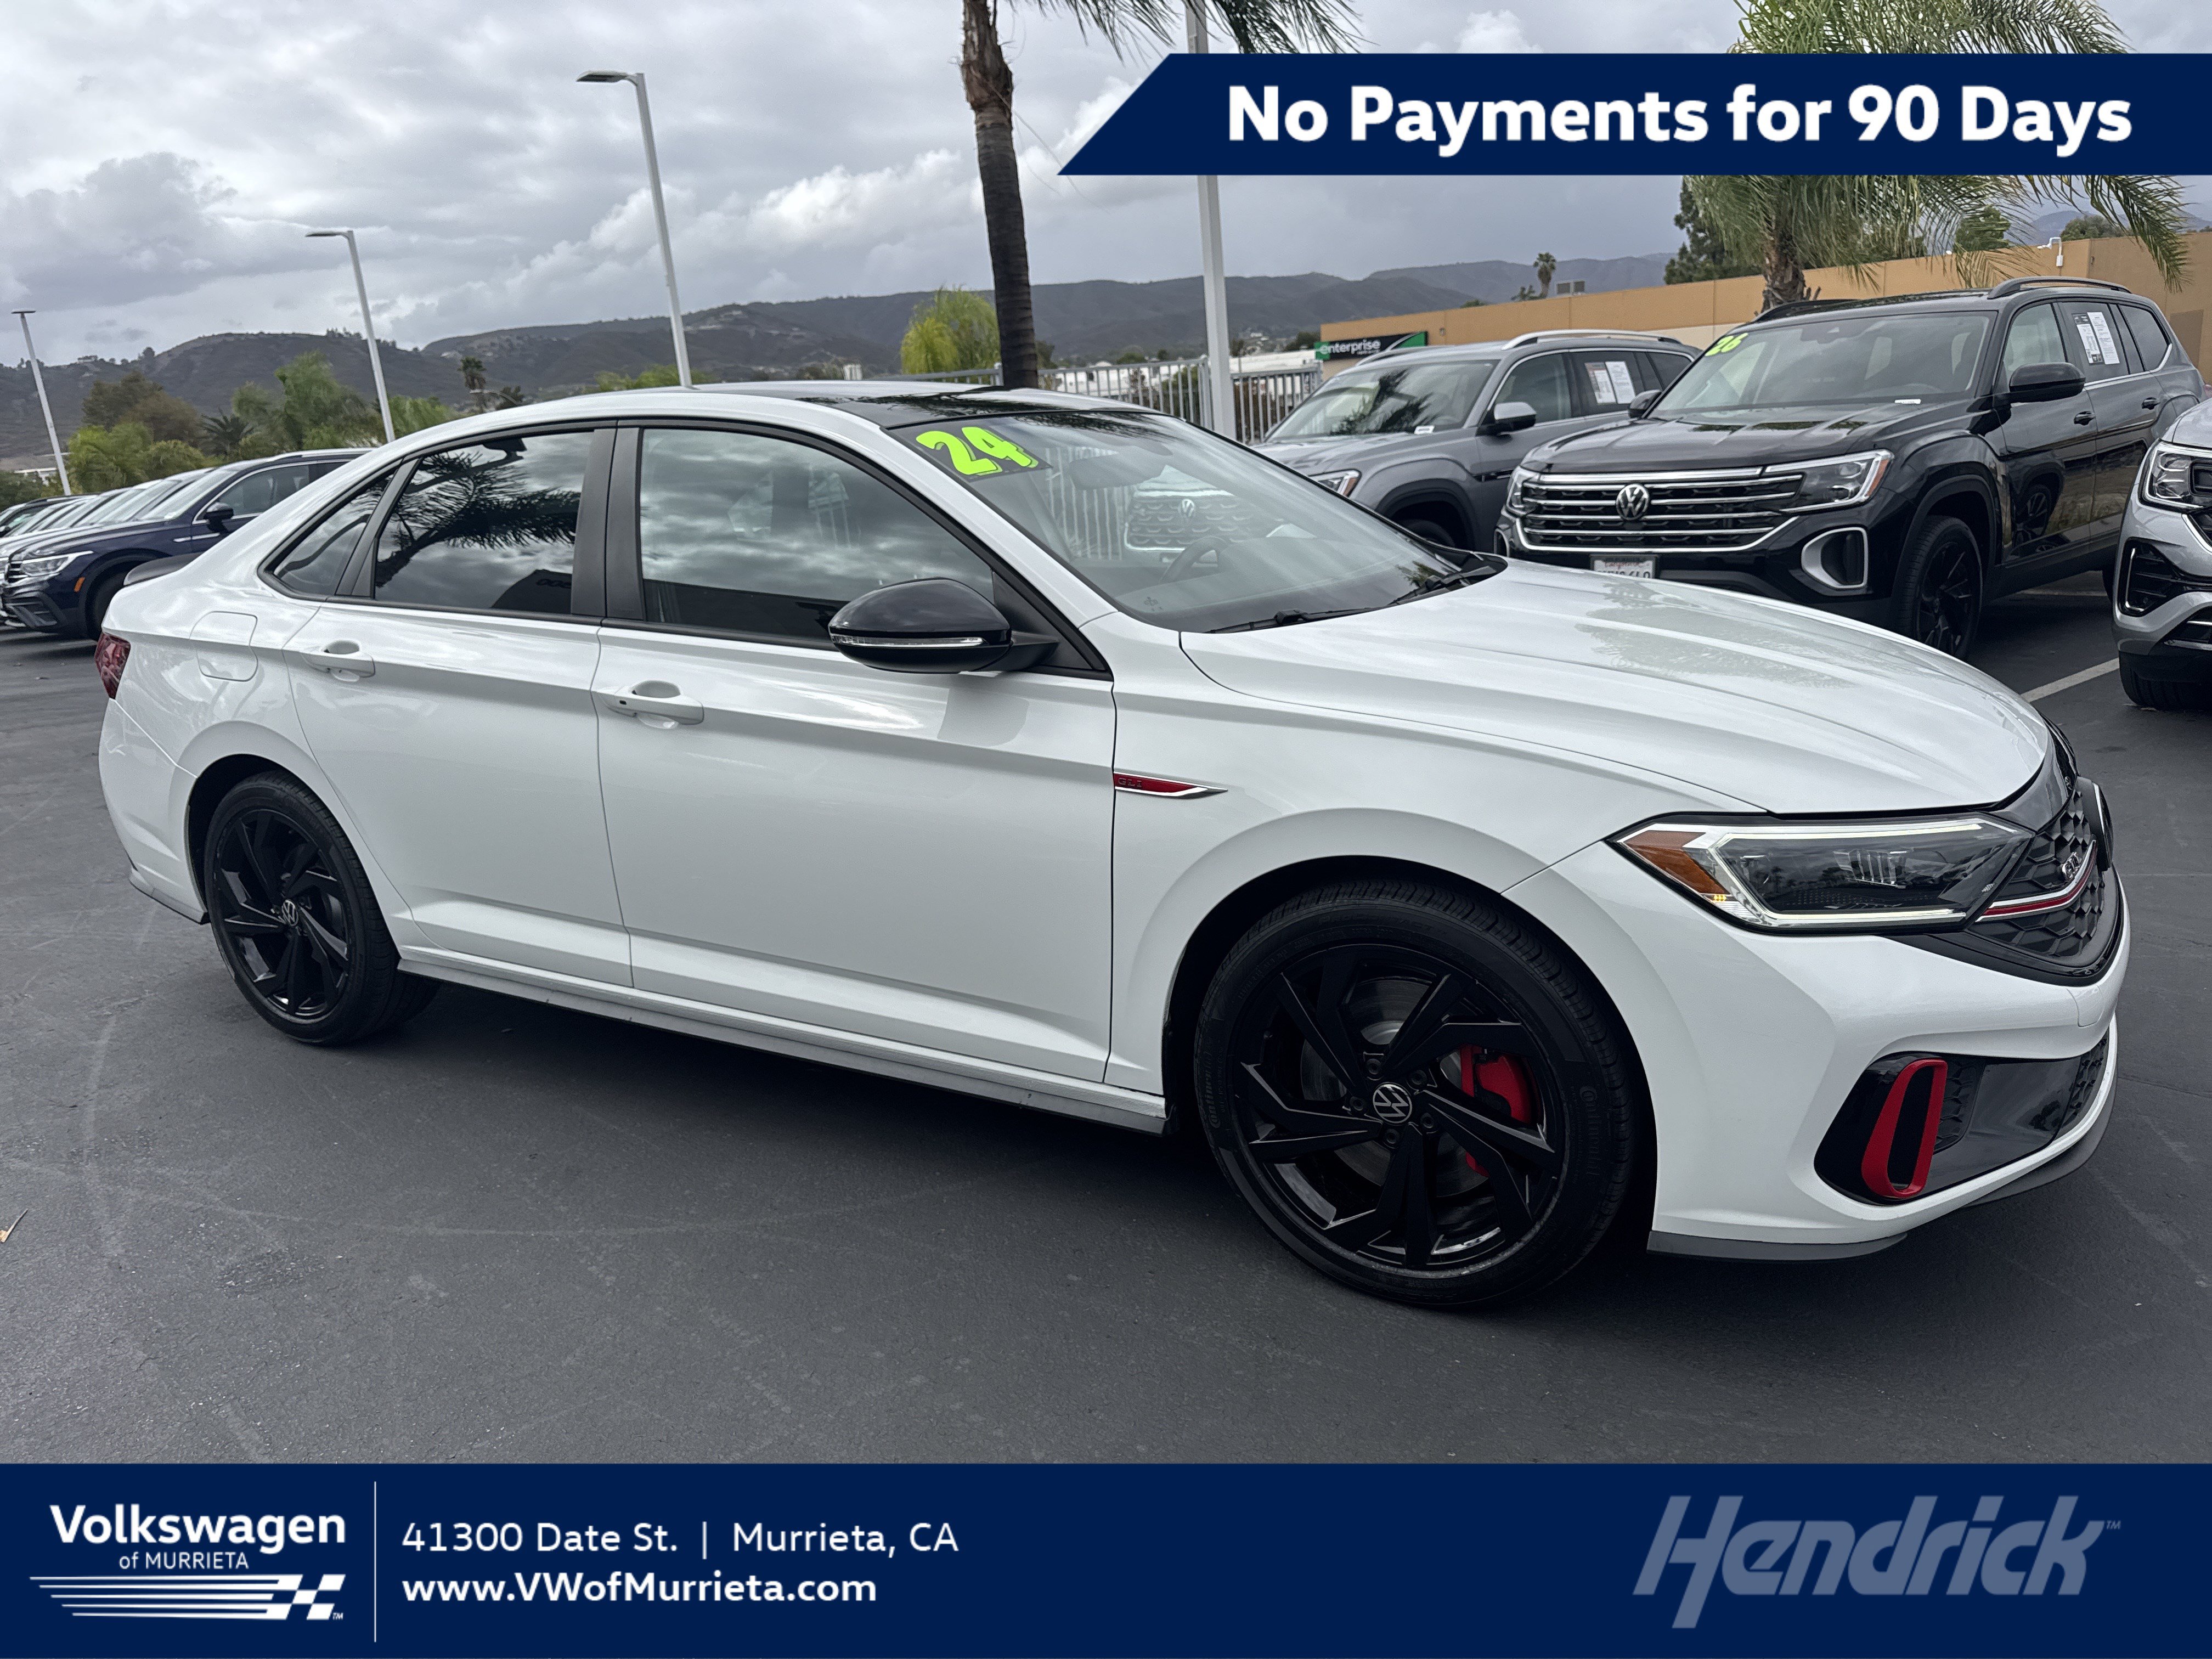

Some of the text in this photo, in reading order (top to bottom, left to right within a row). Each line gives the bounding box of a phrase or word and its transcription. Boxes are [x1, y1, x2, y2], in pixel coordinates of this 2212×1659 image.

[1319, 338, 1381, 355] enterprise
[1705, 332, 1749, 357] 26
[916, 427, 1039, 476] 24
[1118, 777, 1142, 787] GLI
